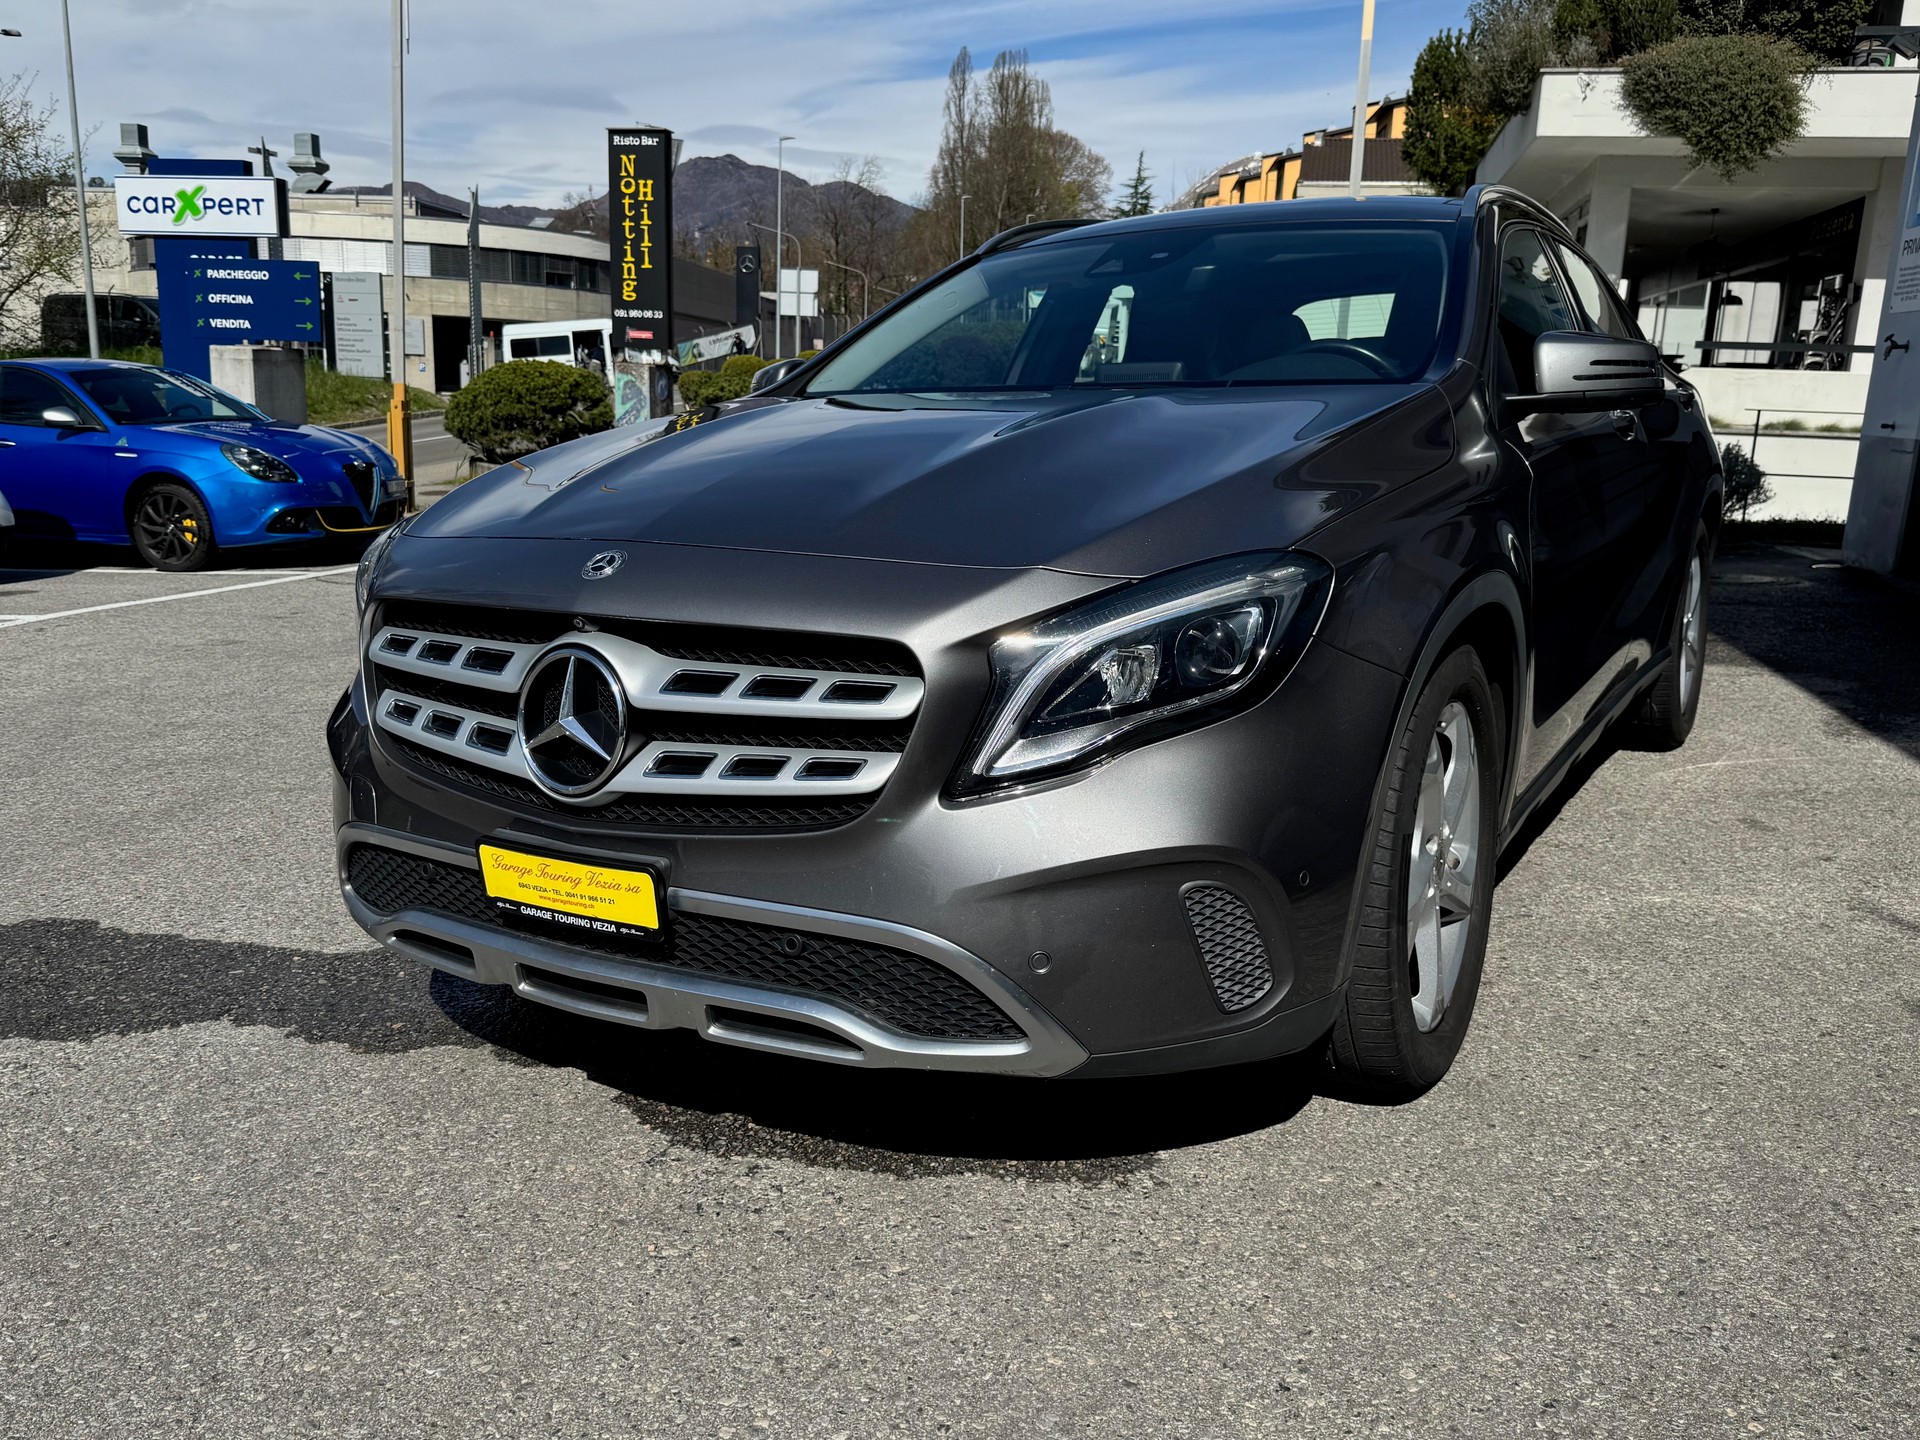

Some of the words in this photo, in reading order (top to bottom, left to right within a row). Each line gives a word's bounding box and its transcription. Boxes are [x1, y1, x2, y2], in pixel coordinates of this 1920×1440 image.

[612, 135, 640, 146] Risto
[641, 135, 660, 146] Bar
[619, 154, 638, 301] Notting
[637, 179, 654, 269] Hill
[206, 269, 270, 281] PARCHEGGIO
[208, 293, 254, 305] OFFICINA
[613, 308, 628, 318] 091
[209, 318, 251, 329] VENDITA
[491, 853, 533, 879] Garage
[535, 863, 582, 890] Touring
[585, 870, 622, 891] Vezia
[625, 883, 641, 894] sa
[518, 882, 531, 890] 6943
[531, 884, 549, 893] VEZIA
[565, 891, 579, 899] 0041
[580, 893, 587, 901] 91
[600, 896, 607, 904] 51
[520, 905, 553, 920] GARAGE
[554, 912, 591, 928] TOURING
[591, 920, 617, 933] VEZIA
